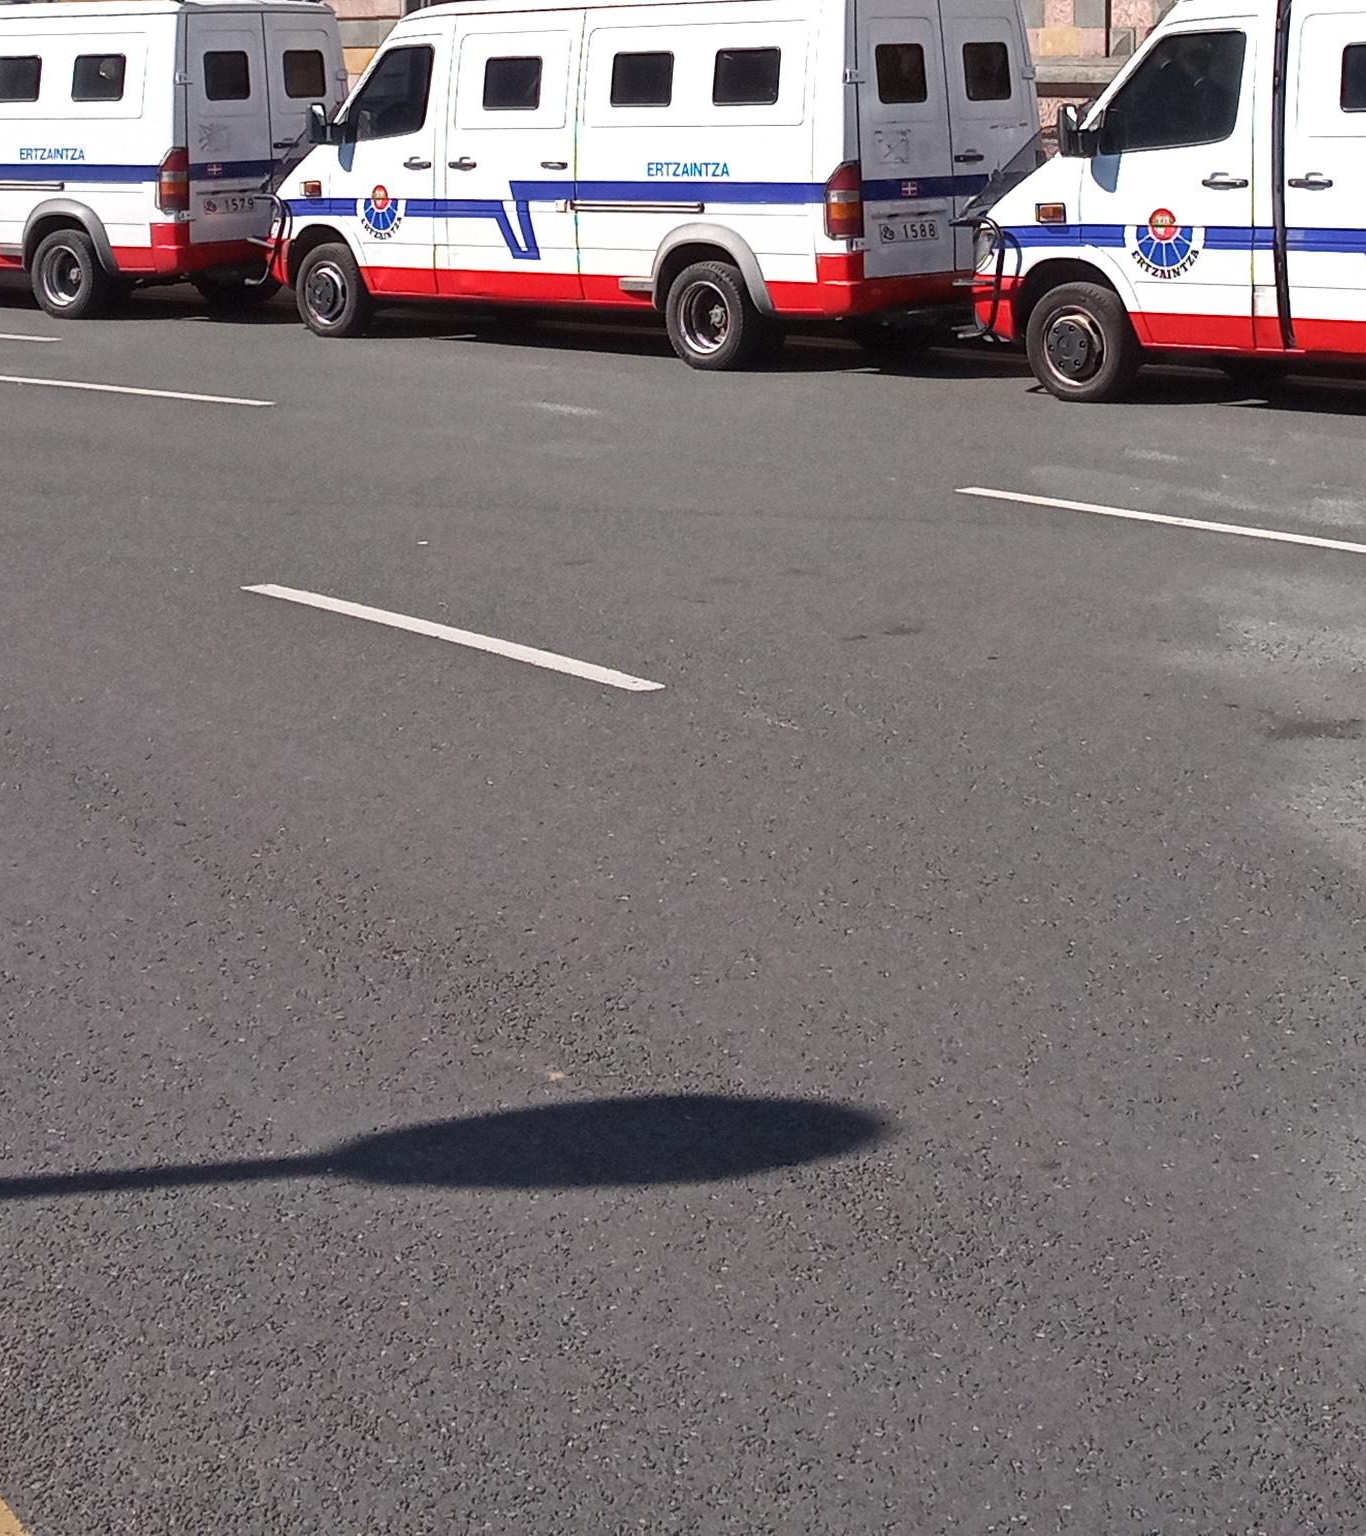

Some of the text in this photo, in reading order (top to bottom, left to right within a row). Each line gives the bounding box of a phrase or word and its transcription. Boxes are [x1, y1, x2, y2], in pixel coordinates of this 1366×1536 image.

[19, 147, 85, 161] ERTZAINTZA
[647, 162, 730, 177] ERTZAINTZA
[225, 198, 255, 212] 1579
[902, 222, 936, 240] 1588
[1131, 249, 1200, 279] ERTZAINTZA
